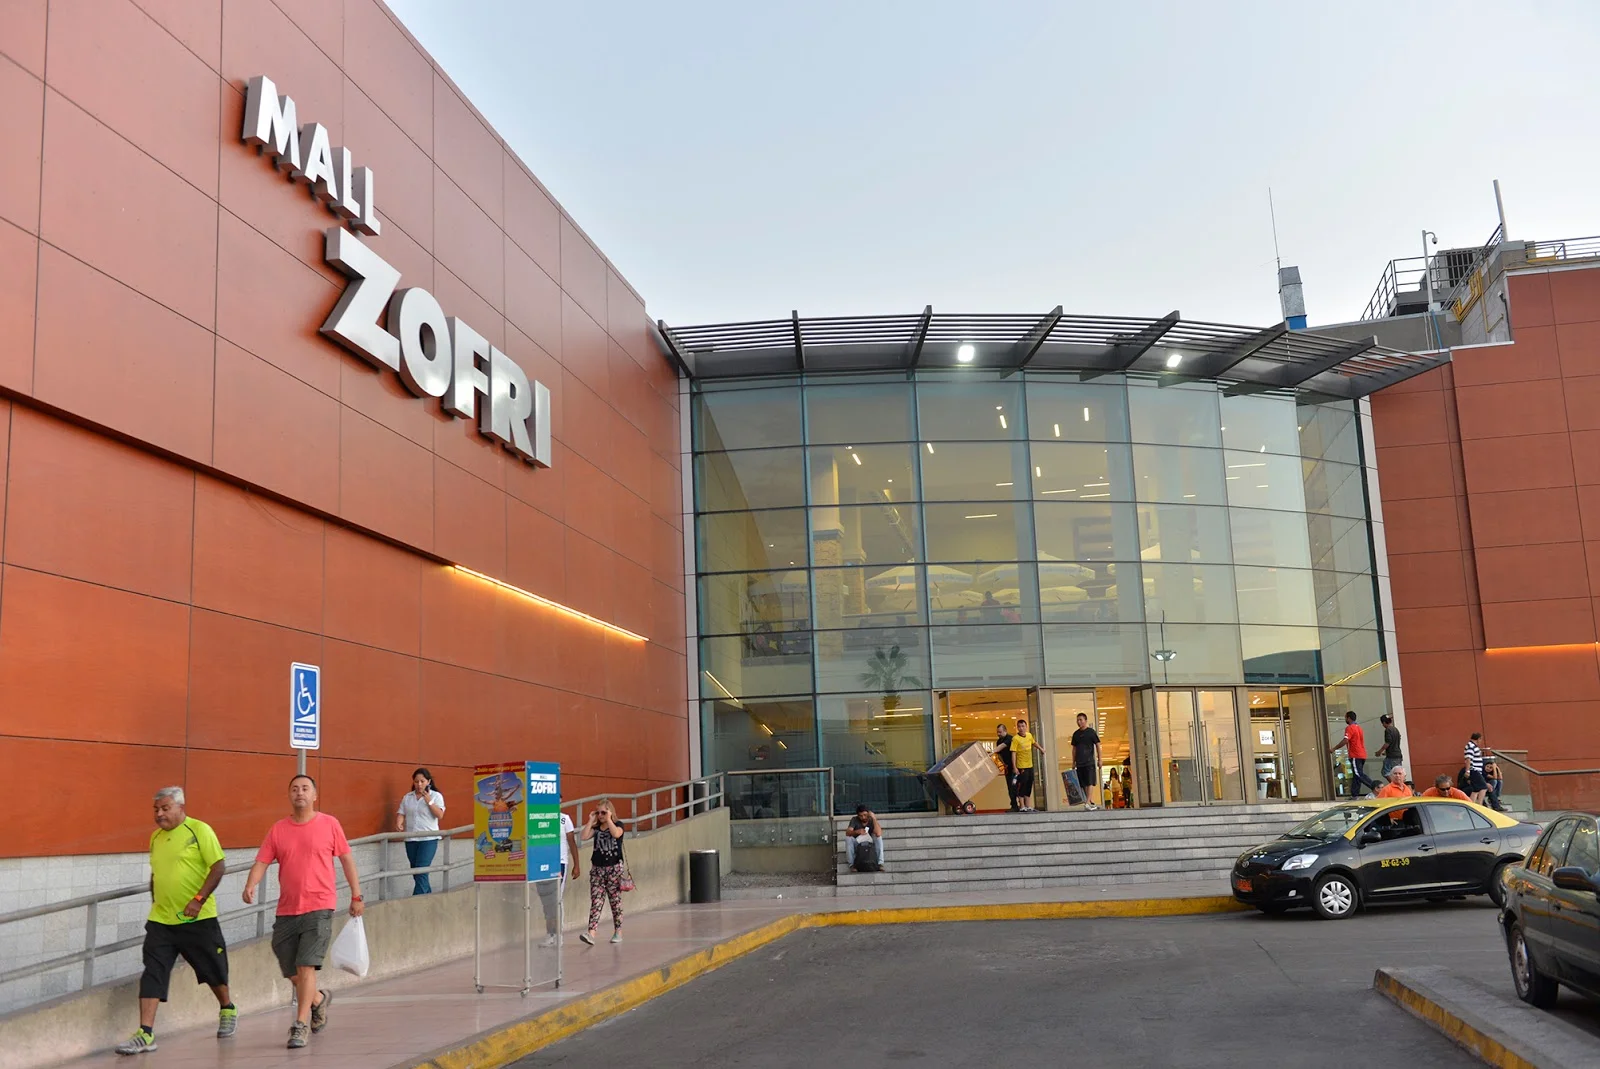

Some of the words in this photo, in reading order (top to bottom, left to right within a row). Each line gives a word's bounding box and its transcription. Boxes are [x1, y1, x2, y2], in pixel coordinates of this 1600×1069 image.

[243, 75, 380, 236] MALL
[320, 226, 552, 469] ZOFRI
[530, 781, 557, 795] ZOFRI
